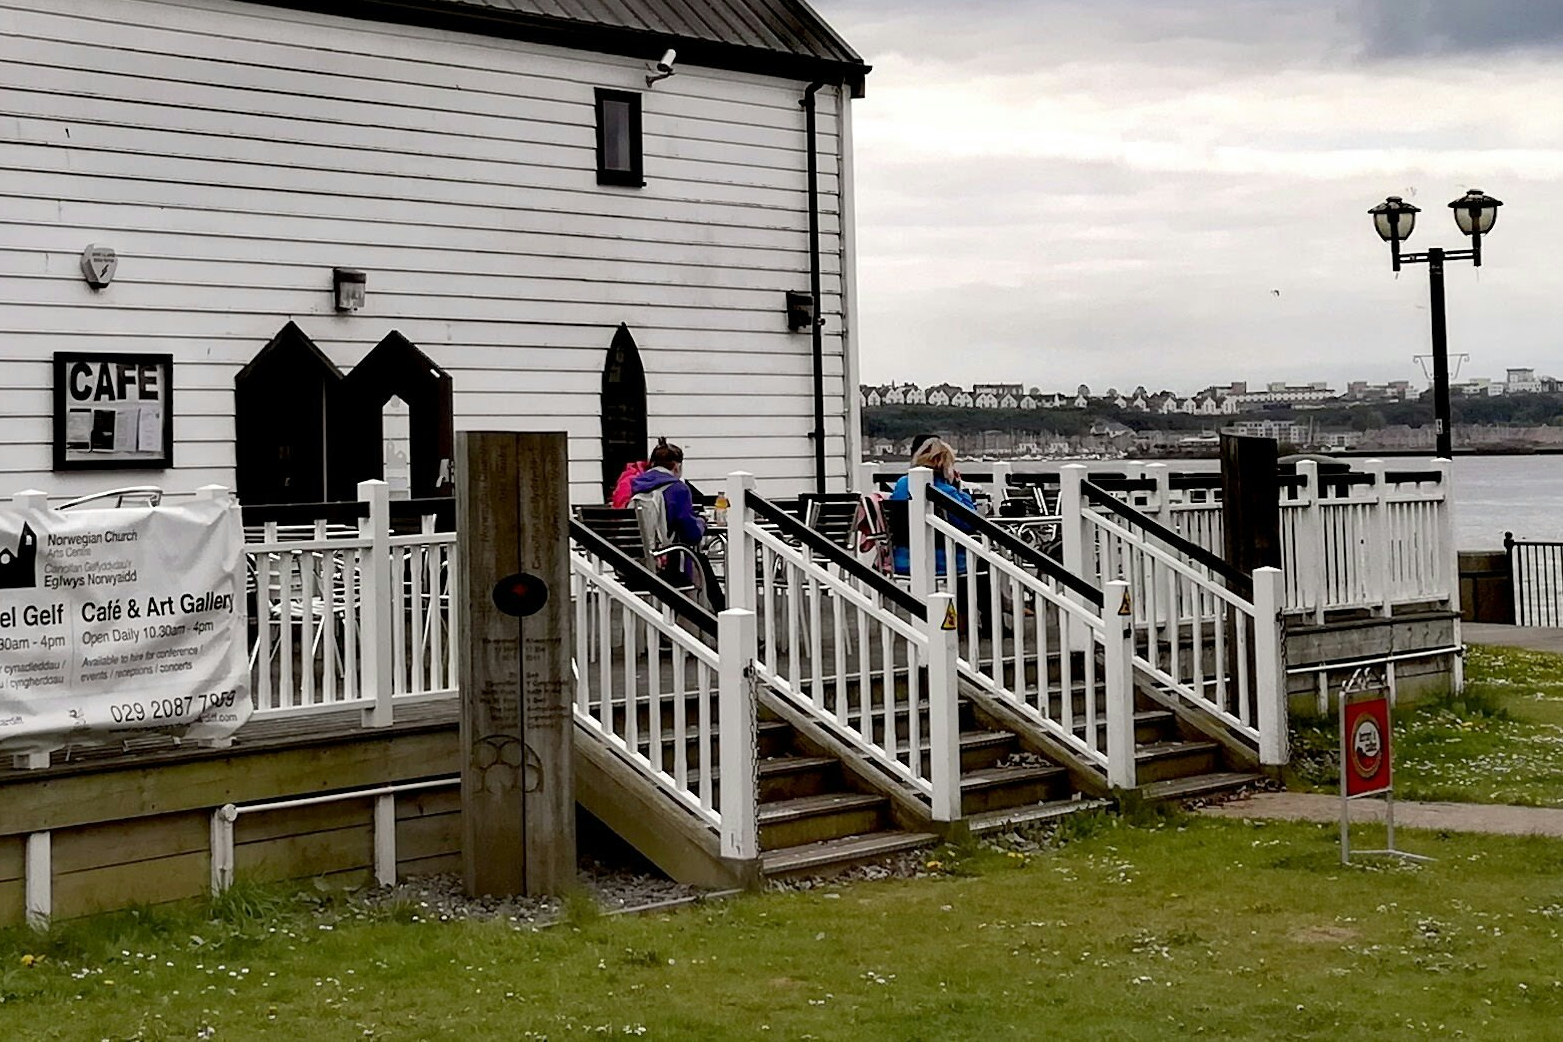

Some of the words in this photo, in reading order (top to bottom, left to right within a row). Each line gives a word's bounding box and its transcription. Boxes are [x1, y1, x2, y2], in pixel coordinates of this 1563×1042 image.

[70, 362, 159, 401] CAFE
[47, 532, 102, 548] Norwegian
[105, 530, 138, 542] Church
[44, 574, 85, 589] Eglwys
[88, 569, 137, 586] Norwyaidd
[23, 603, 64, 626] Gelf
[82, 598, 122, 622] Café
[127, 598, 141, 618] &
[146, 596, 175, 617] Art
[180, 591, 234, 614] Gallery
[41, 635, 66, 649] 4pm
[82, 630, 110, 647] Open
[113, 626, 140, 643] Daily
[143, 624, 185, 639] 10.30am
[192, 621, 214, 635] 4pm
[82, 655, 119, 668] Available
[120, 653, 128, 663] to
[145, 650, 156, 660] for
[156, 646, 198, 659] conference
[80, 671, 108, 682] events
[110, 702, 145, 723] 029
[150, 696, 193, 719] 2087
[198, 690, 236, 713] 7959
